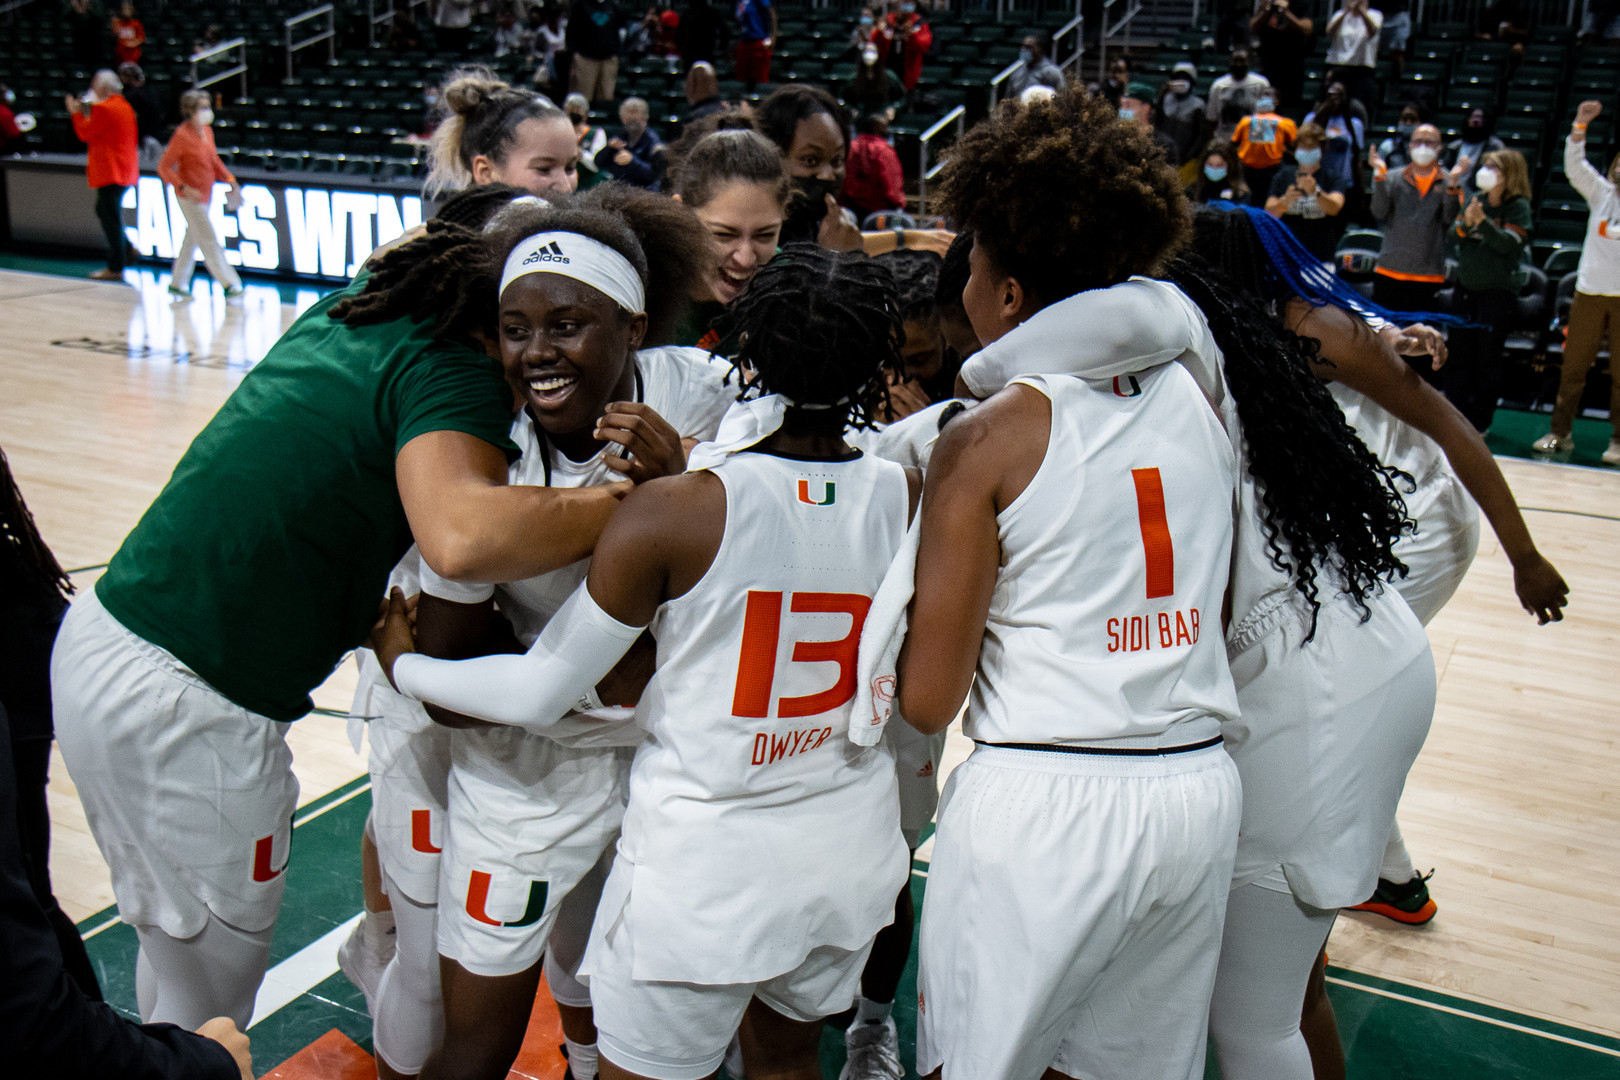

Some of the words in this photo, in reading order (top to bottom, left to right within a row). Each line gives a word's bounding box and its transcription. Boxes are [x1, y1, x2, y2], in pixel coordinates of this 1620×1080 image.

[522, 253, 571, 266] adidas
[1112, 375, 1142, 397] U
[798, 480, 836, 506] U
[1131, 467, 1174, 599] 1
[1107, 614, 1150, 652] SIDI
[732, 590, 873, 718] 13
[751, 727, 832, 765] DWYER
[465, 870, 550, 928] U
